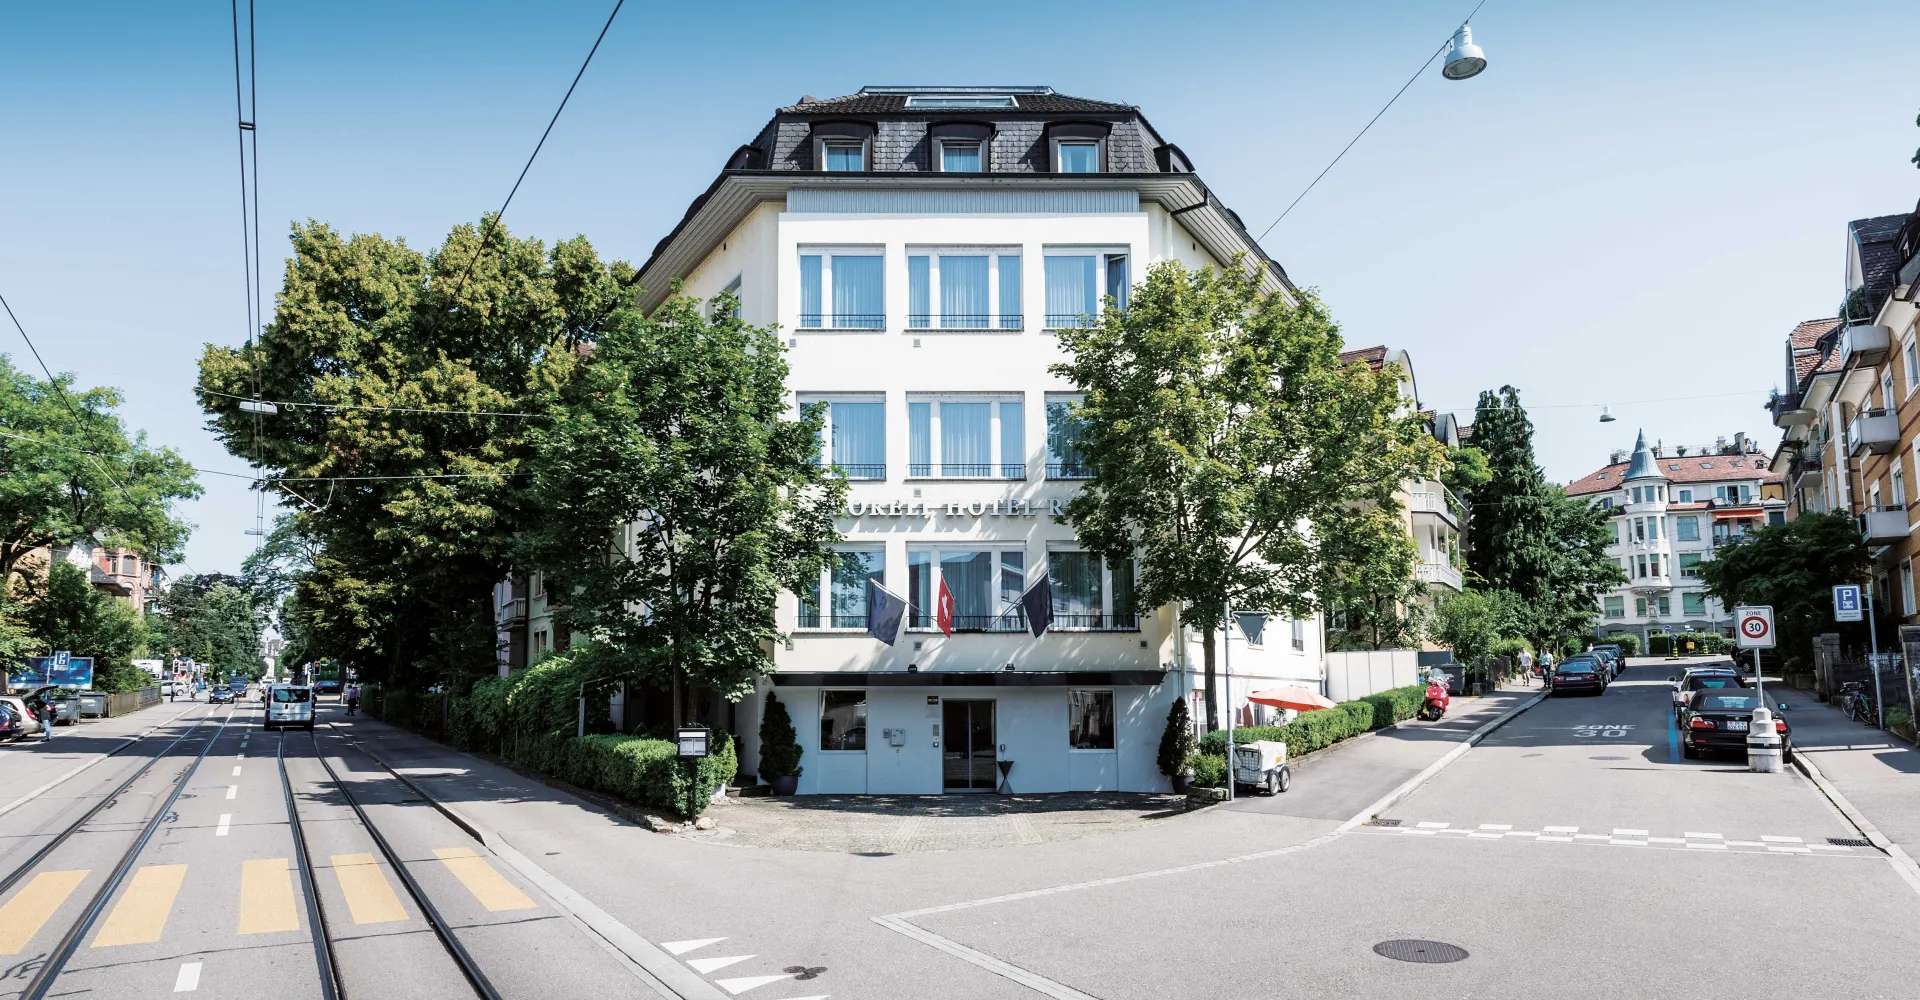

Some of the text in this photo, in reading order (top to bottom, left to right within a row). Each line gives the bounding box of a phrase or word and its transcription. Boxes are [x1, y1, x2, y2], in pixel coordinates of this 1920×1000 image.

[833, 499, 937, 516] ORELL
[945, 499, 1036, 516] HOTEL
[1748, 622, 1761, 632] 30
[1572, 729, 1627, 738] 30
